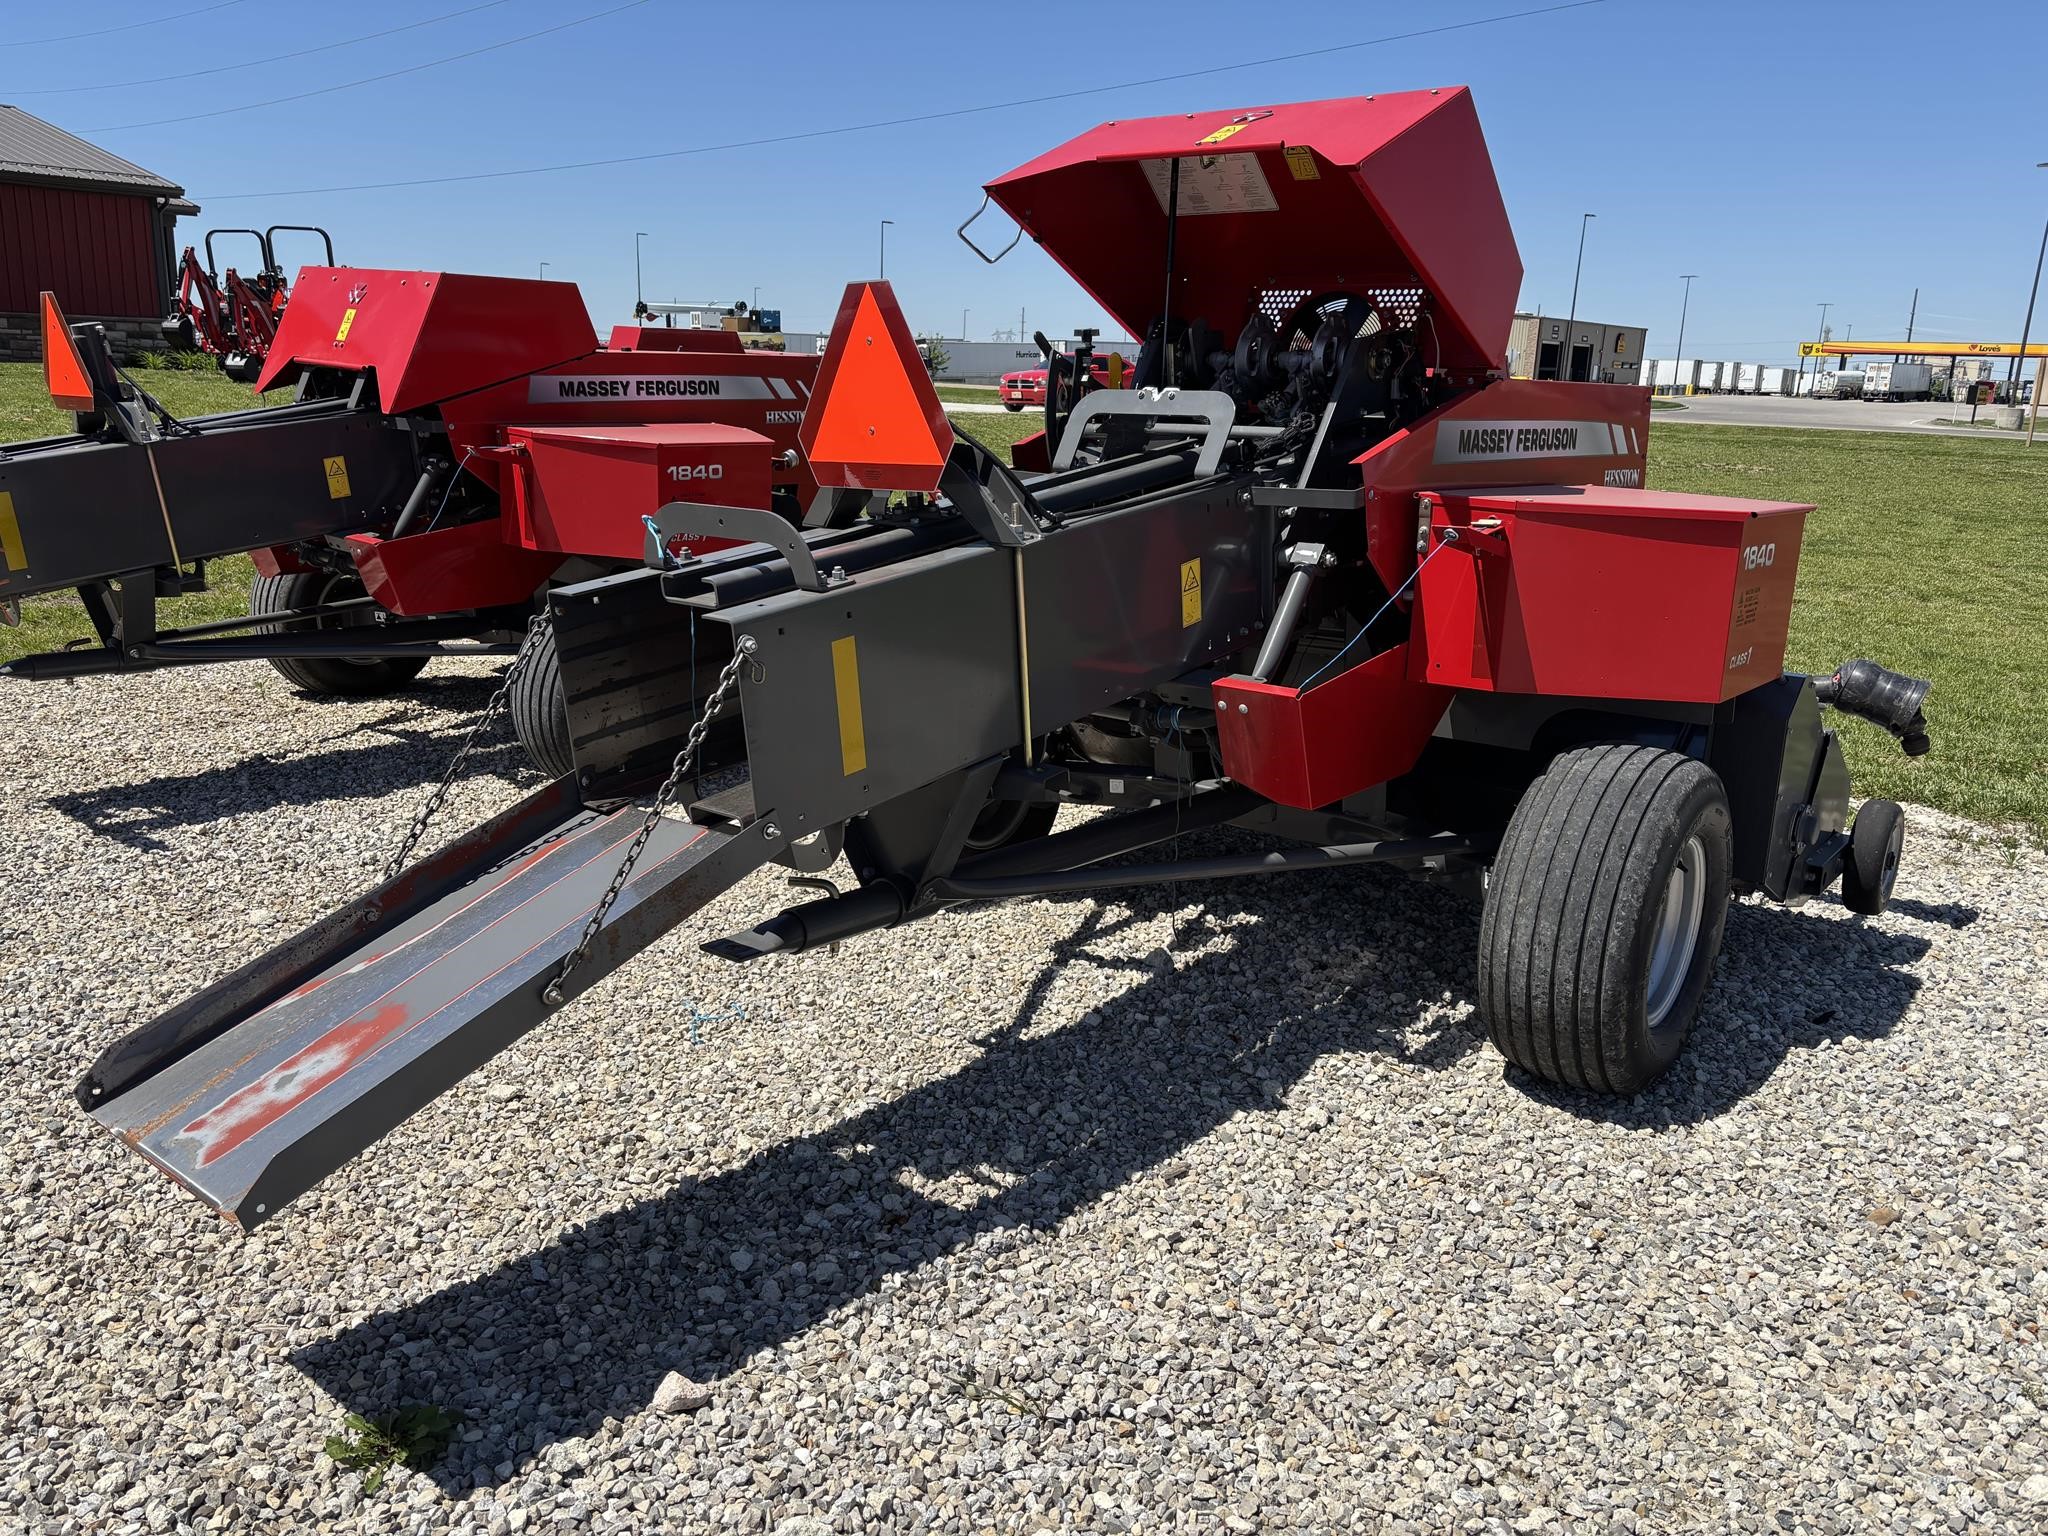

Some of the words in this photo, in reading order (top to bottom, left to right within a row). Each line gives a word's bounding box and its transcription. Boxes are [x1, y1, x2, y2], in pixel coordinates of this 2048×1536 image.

[1015, 350, 1042, 359] Hurrican
[1978, 344, 2002, 353] Love's
[558, 380, 631, 397] MASSEY
[636, 379, 720, 396] FERGUSON
[1458, 429, 1515, 454] MASSEY
[1515, 427, 1578, 452] FERGUSON
[667, 463, 723, 481] 1840
[1604, 468, 1640, 486] HESSTON
[1743, 543, 1776, 571] 1840
